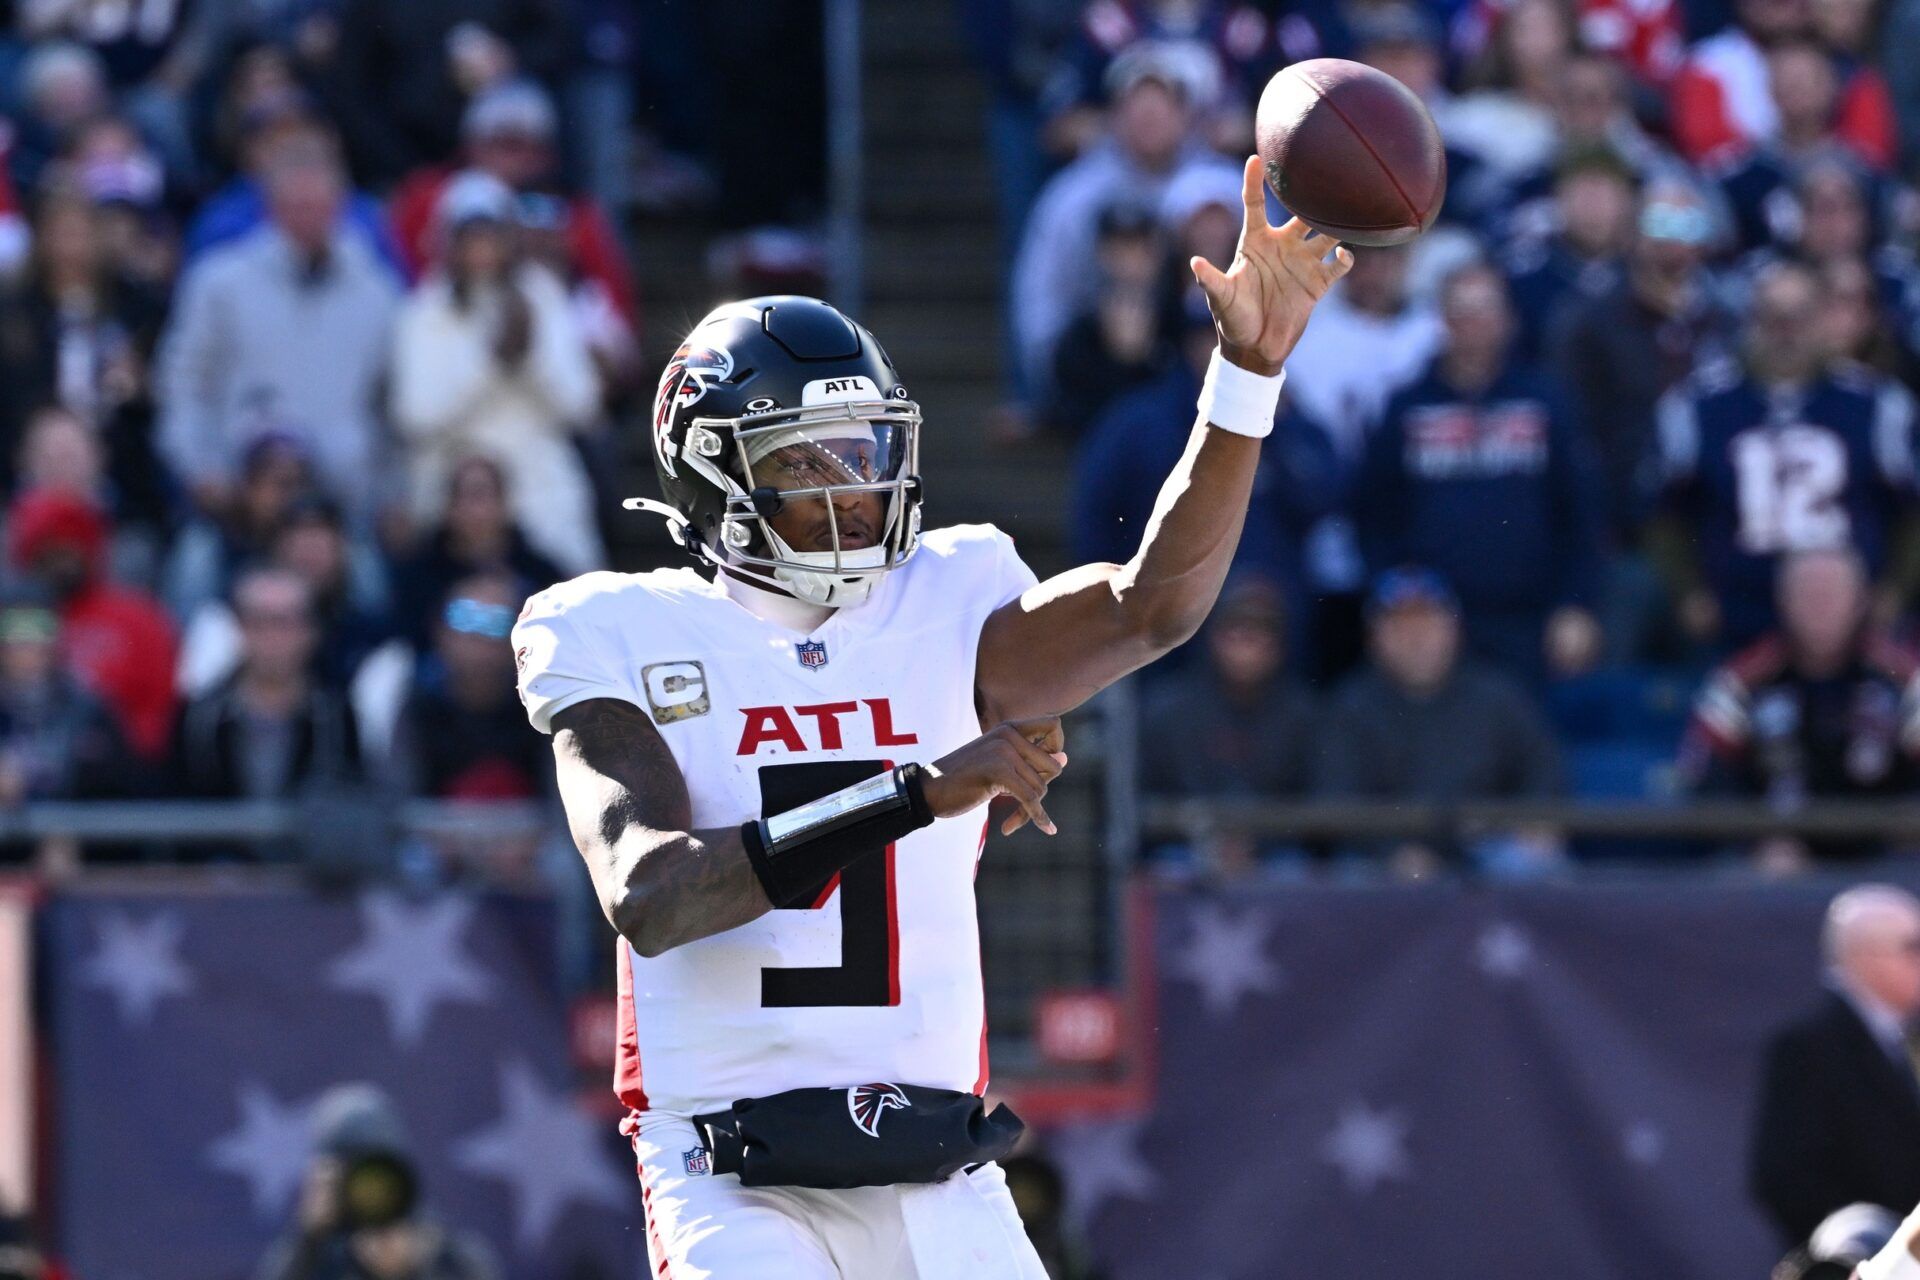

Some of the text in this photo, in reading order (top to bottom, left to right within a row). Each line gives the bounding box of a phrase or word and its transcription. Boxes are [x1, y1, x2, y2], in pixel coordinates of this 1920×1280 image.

[825, 379, 864, 394] ATL
[1733, 426, 1850, 553] 12
[801, 651, 824, 665] NFL
[647, 663, 703, 708] C
[737, 698, 918, 756] ATL
